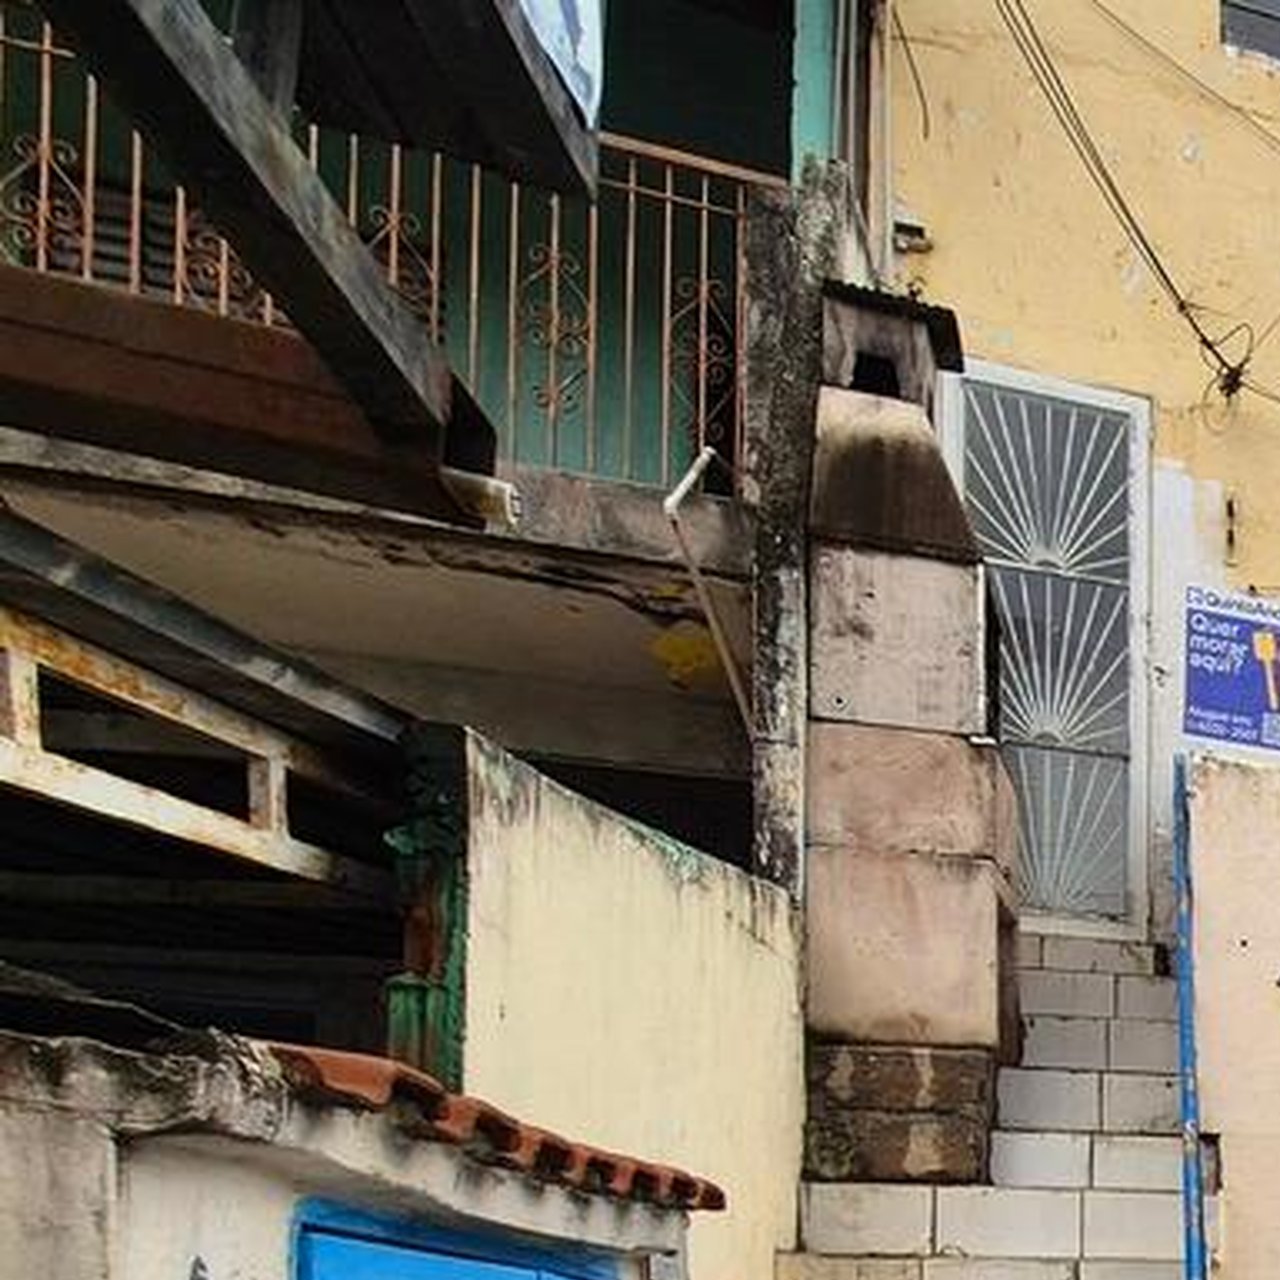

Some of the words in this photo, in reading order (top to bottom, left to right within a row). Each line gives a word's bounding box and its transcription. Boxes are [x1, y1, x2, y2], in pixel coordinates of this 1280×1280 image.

[1190, 612, 1241, 638] Quer
[1189, 635, 1249, 659] morar
[1189, 652, 1244, 674] aqui?
